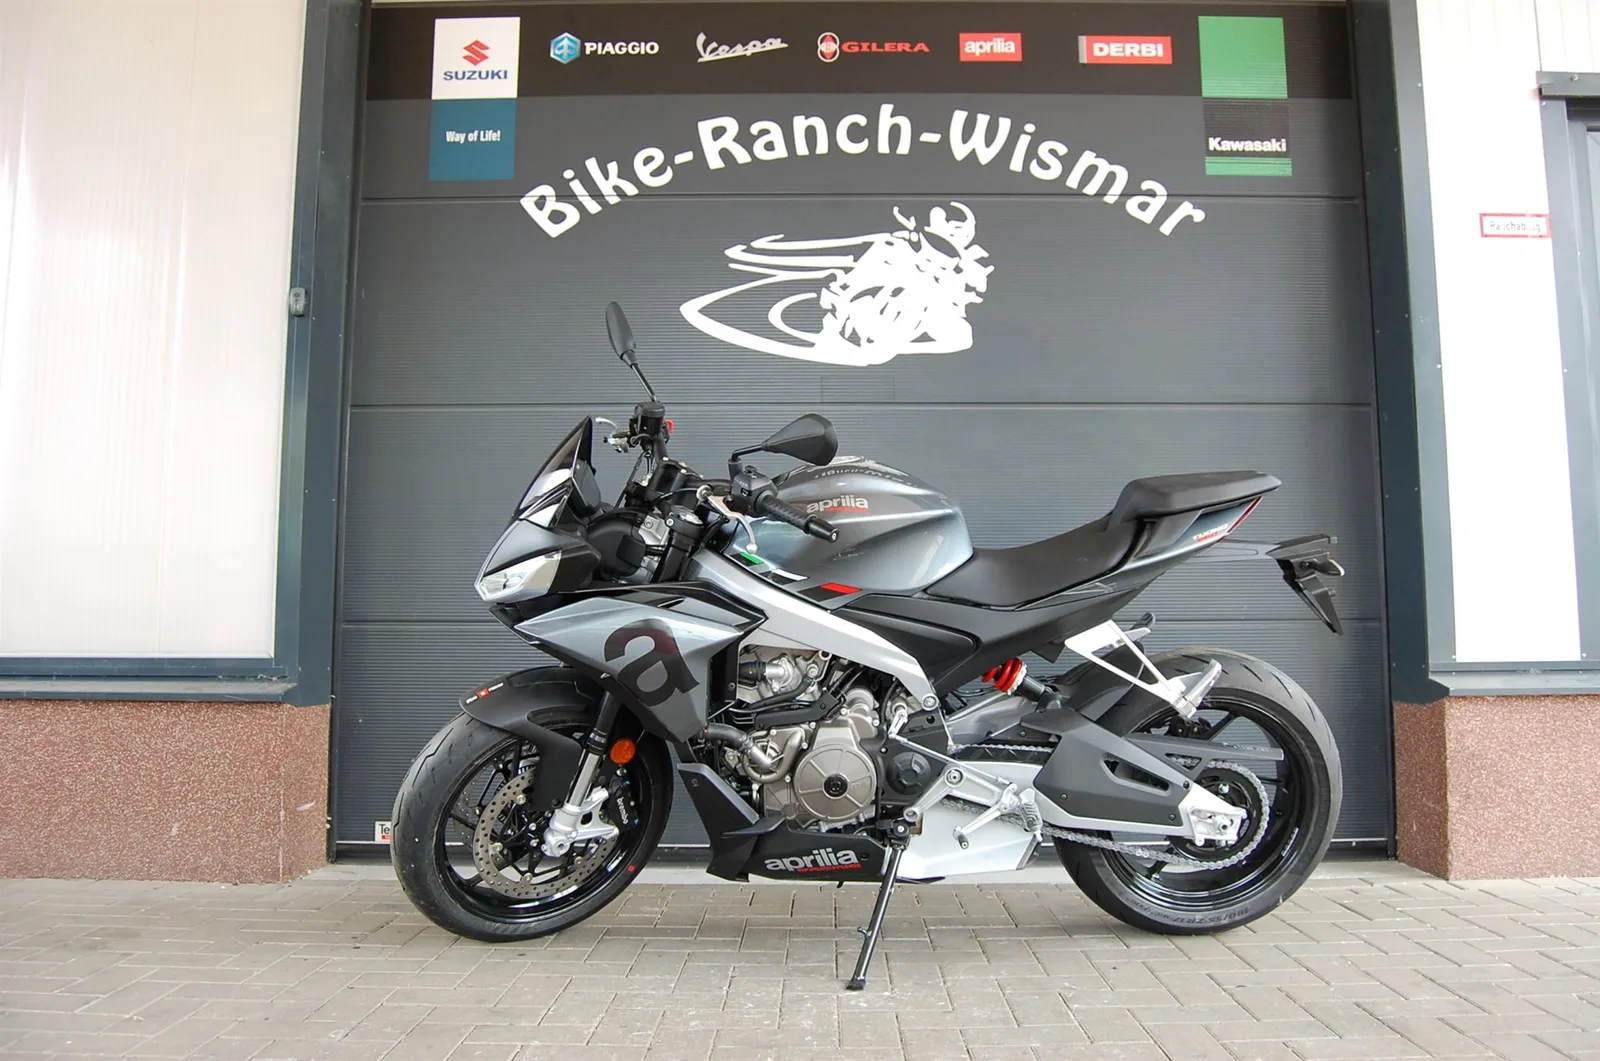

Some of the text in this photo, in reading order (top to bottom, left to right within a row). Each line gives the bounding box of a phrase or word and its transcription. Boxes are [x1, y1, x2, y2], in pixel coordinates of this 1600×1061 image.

[584, 41, 660, 55] PIAGGIO
[696, 32, 789, 63] Vespa
[841, 40, 931, 54] GILERA
[963, 38, 1016, 56] aprilia
[1092, 42, 1164, 57] DERBI
[443, 69, 508, 81] SUZUKI
[445, 129, 501, 144] Way of Life!
[1208, 137, 1287, 152] Kawasaki
[519, 103, 1206, 238] Bike-Ranch-Wismar
[806, 495, 869, 513] aprilia
[603, 618, 700, 707] a
[616, 796, 629, 825] brembo
[764, 847, 860, 872] aprilia
